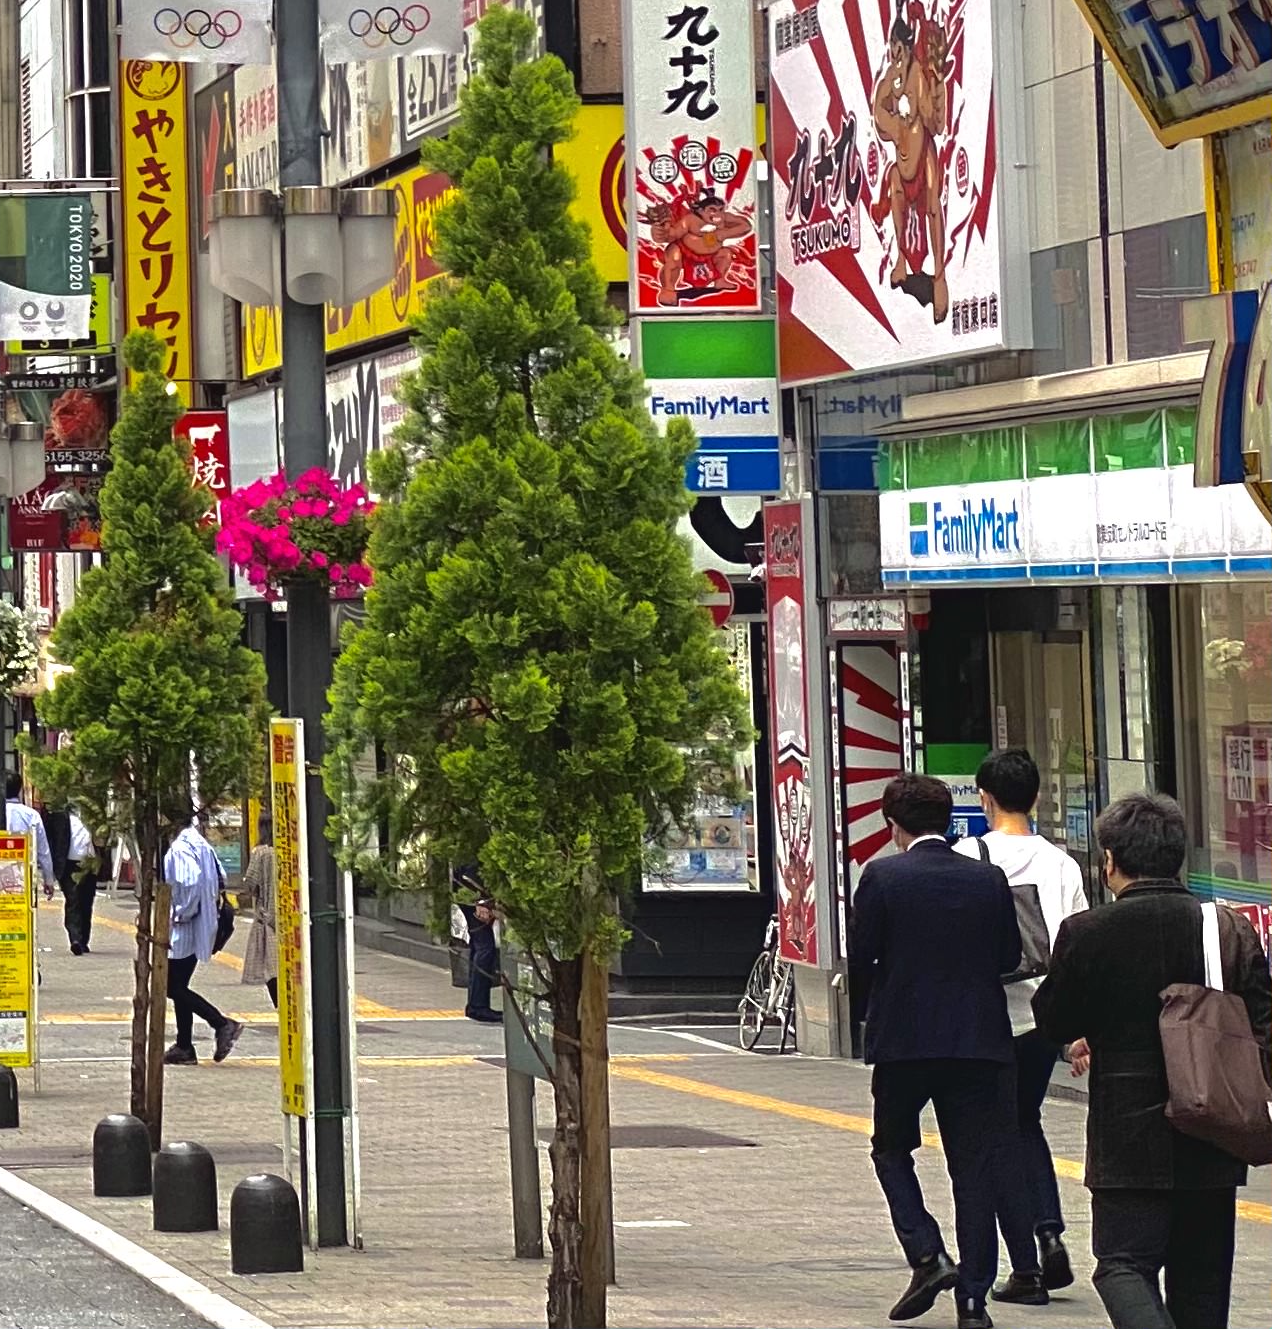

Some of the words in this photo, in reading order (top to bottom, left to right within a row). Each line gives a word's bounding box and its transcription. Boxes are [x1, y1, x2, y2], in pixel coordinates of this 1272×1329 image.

[661, 6, 719, 120] 九十九
[785, 112, 860, 224] 九十九
[69, 204, 83, 251] TOKYO
[790, 214, 856, 265] TSUKUMO
[69, 254, 83, 291] 2020
[651, 394, 771, 419] FamilyMart
[696, 455, 729, 488] 酒
[933, 498, 1021, 559] FamilyMart
[1230, 774, 1252, 801] ATM
